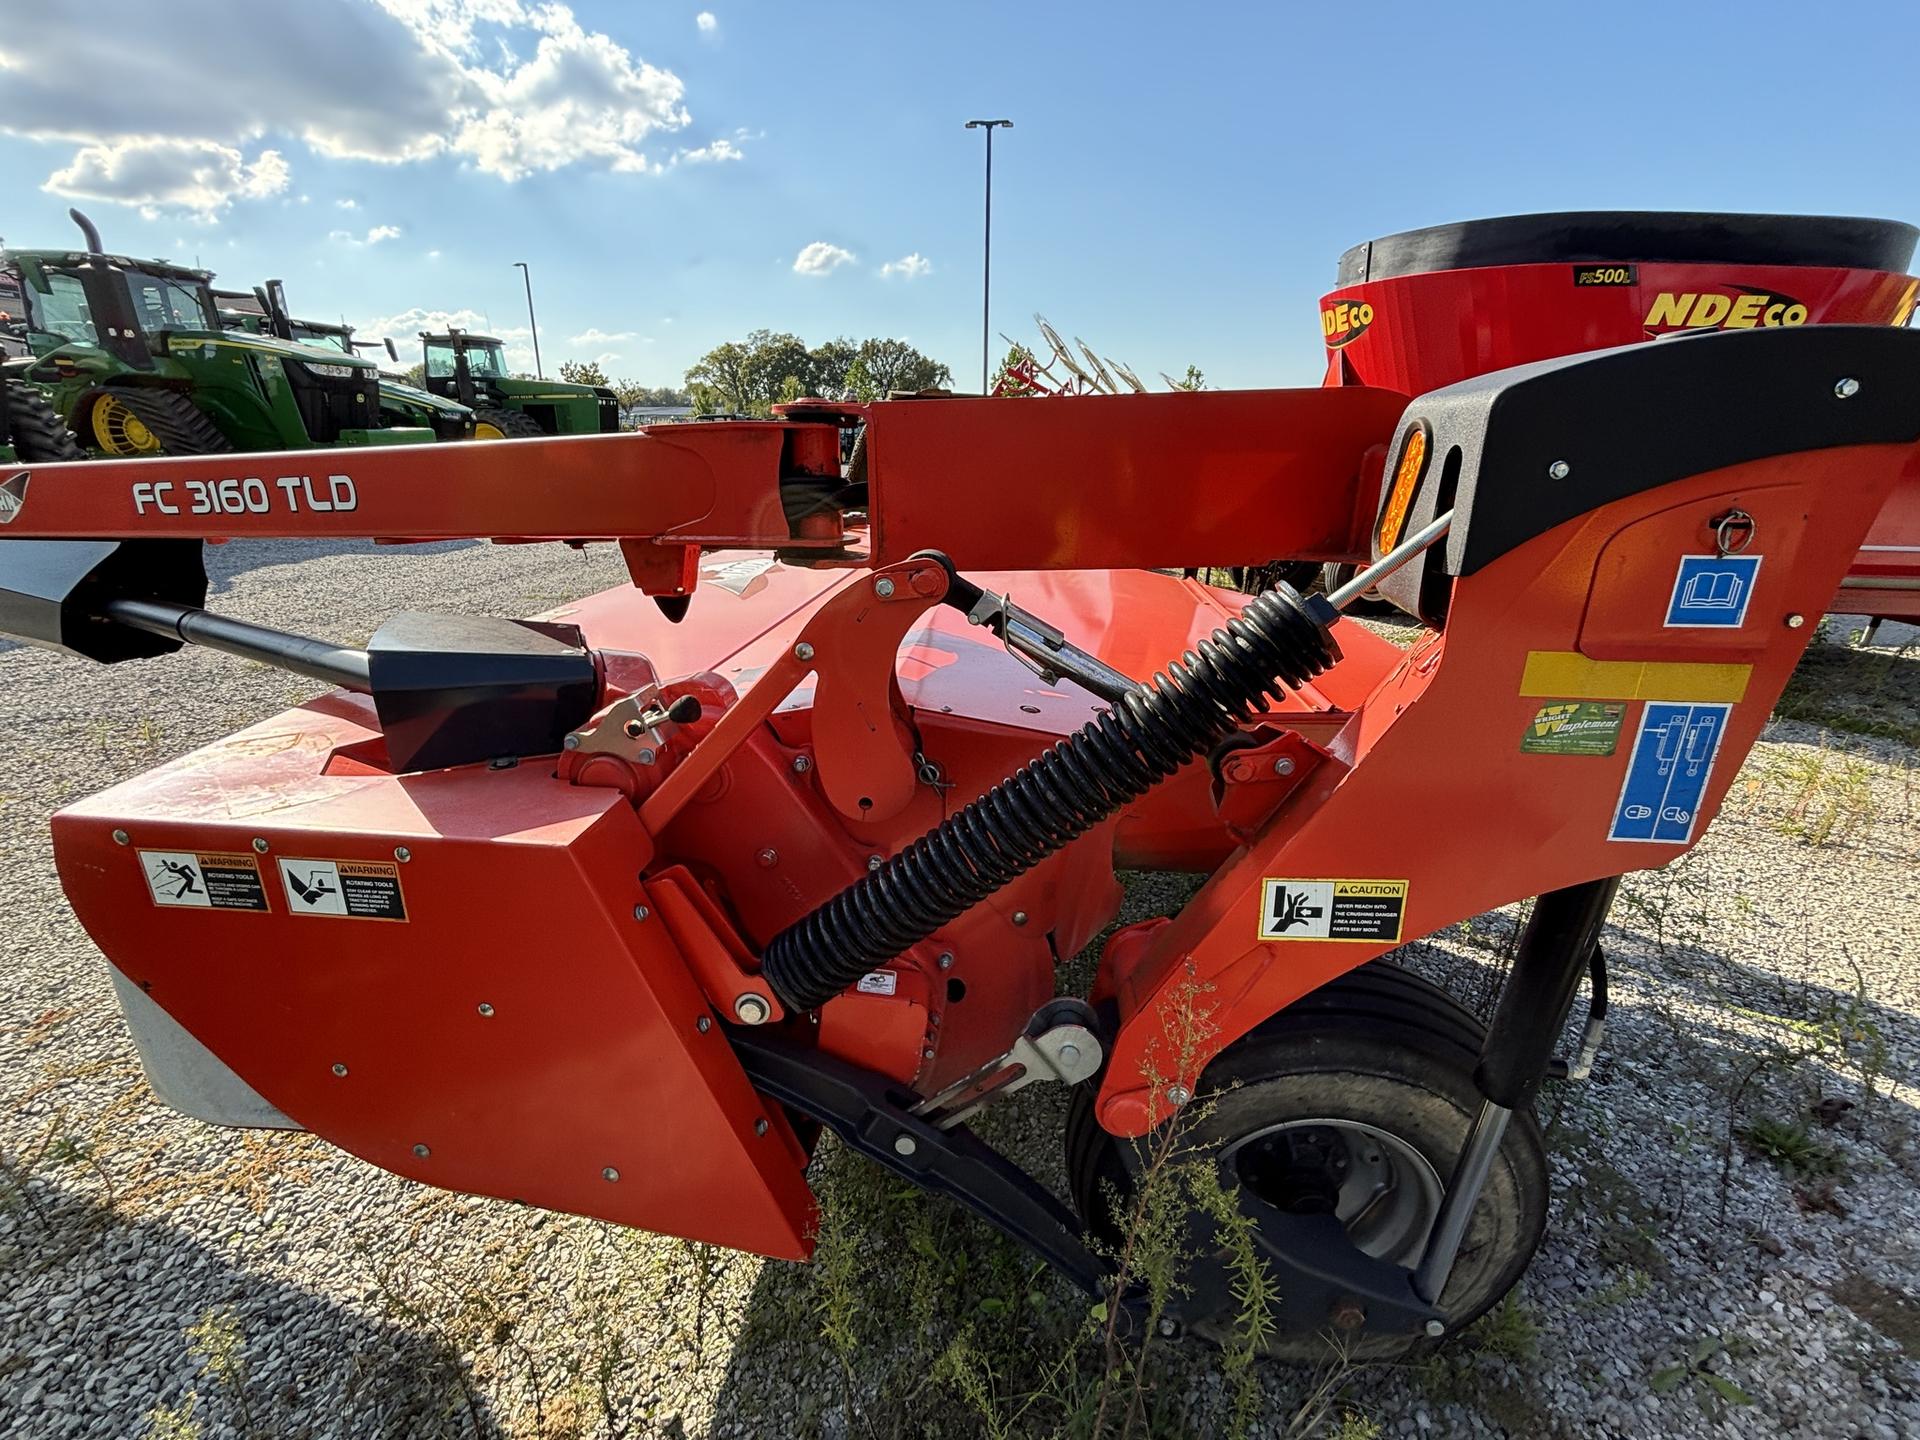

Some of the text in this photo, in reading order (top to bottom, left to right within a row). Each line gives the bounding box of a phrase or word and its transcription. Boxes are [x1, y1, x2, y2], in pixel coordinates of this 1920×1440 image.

[1579, 268, 1631, 284] FS500L
[132, 474, 359, 515] FC 3160 TLD
[1556, 720, 1619, 733] Implement
[208, 857, 253, 867] WARNING
[348, 865, 394, 875] WARNING
[1350, 885, 1400, 895] CAUTION
